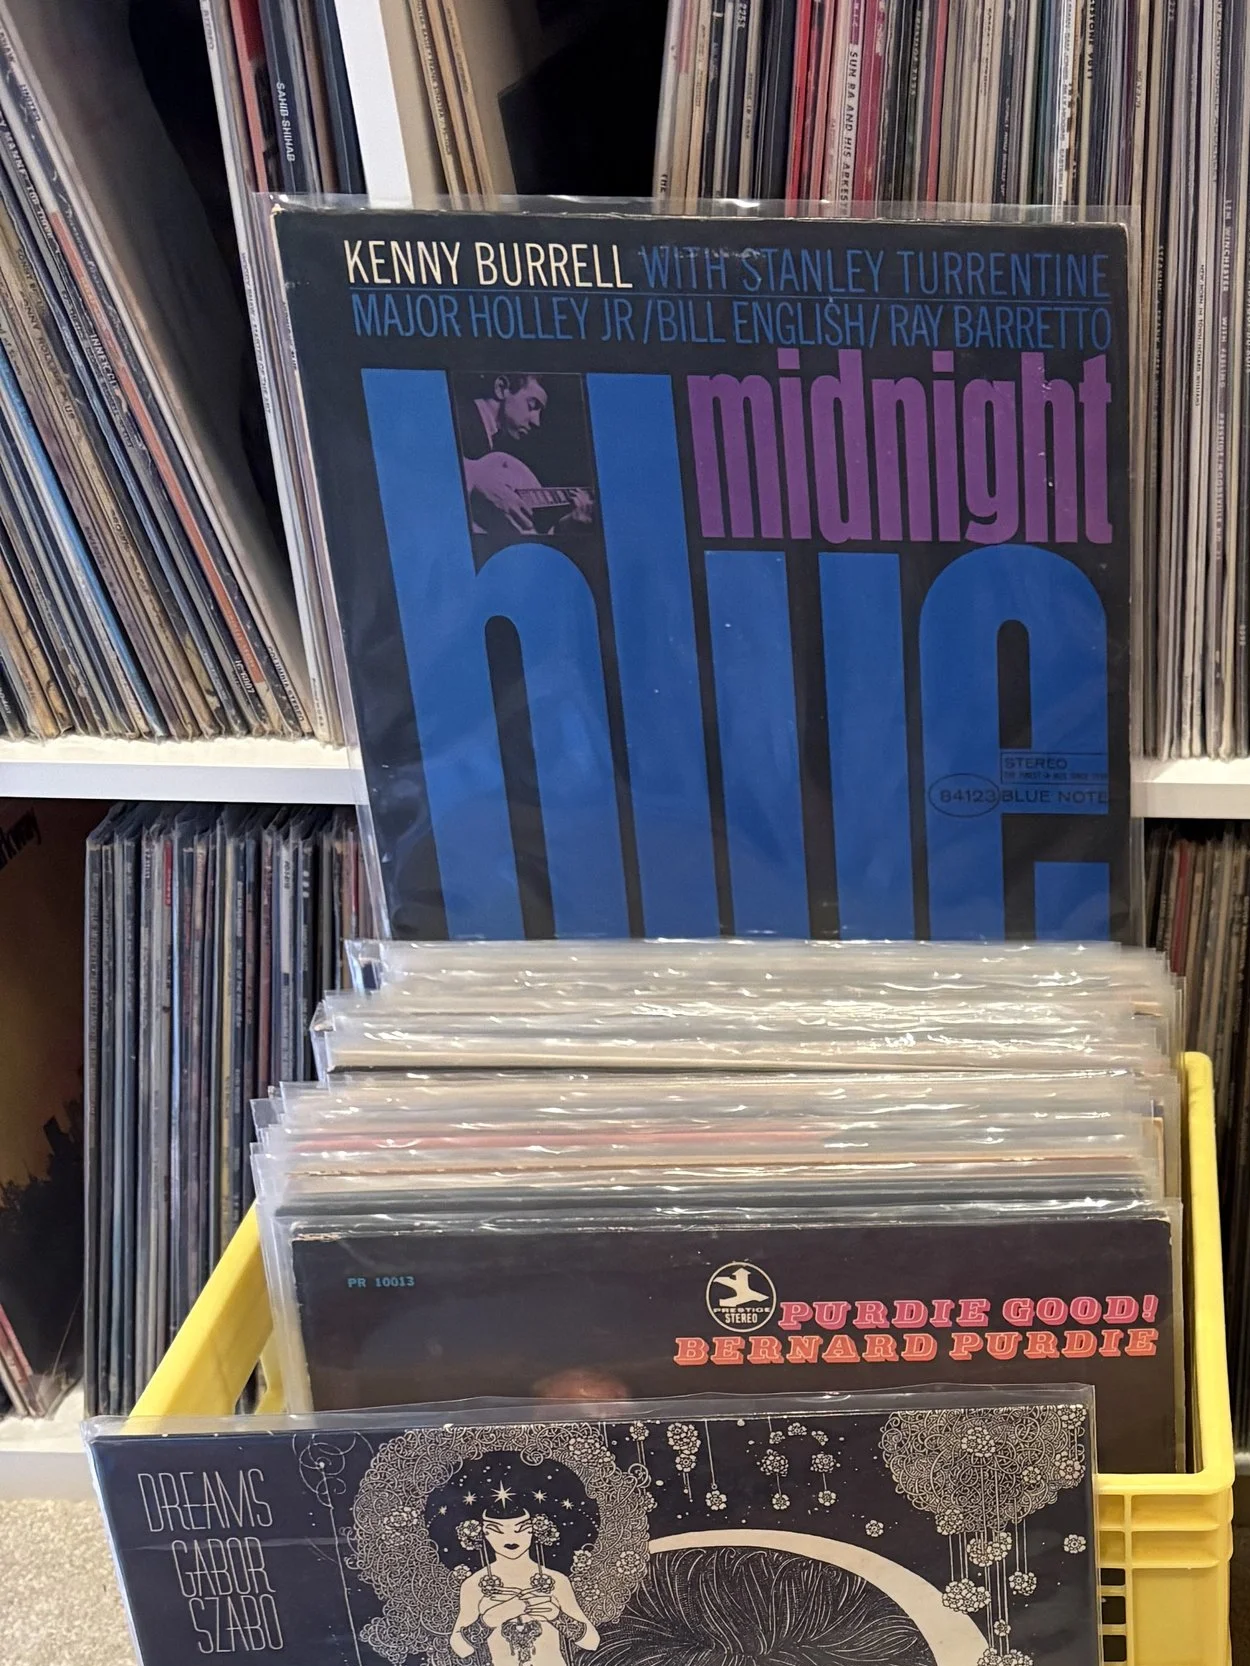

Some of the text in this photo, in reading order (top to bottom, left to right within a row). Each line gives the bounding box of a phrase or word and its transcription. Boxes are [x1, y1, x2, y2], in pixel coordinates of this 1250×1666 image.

[275, 81, 295, 161] SAHIB SHIHAB
[843, 51, 858, 157] SUN RA AND HIS
[344, 240, 1111, 299] KENNY BURRELL WITH STANLEY TURRENTINE
[1222, 226, 1230, 291] WINCHESTER
[352, 294, 461, 338] MAJOR
[471, 297, 589, 340] HOLLEY
[890, 306, 940, 348] RAY
[954, 307, 1112, 350] BARRETTO
[687, 349, 1114, 545] midnight
[360, 366, 1113, 941] blue
[1004, 757, 1068, 770] STEREO
[940, 789, 1109, 804] 84123 BLUE NOTE
[347, 1276, 415, 1288] PR 10013
[712, 1307, 772, 1315] PRESTIGE
[724, 1314, 759, 1325] STEREO
[777, 1294, 1159, 1331] PURDIE GOOD!
[673, 1327, 1159, 1366] BERNARD PURDIE
[137, 1468, 274, 1533] DREAMS
[170, 1536, 277, 1599] GABOR
[188, 1593, 285, 1655] SZABO
